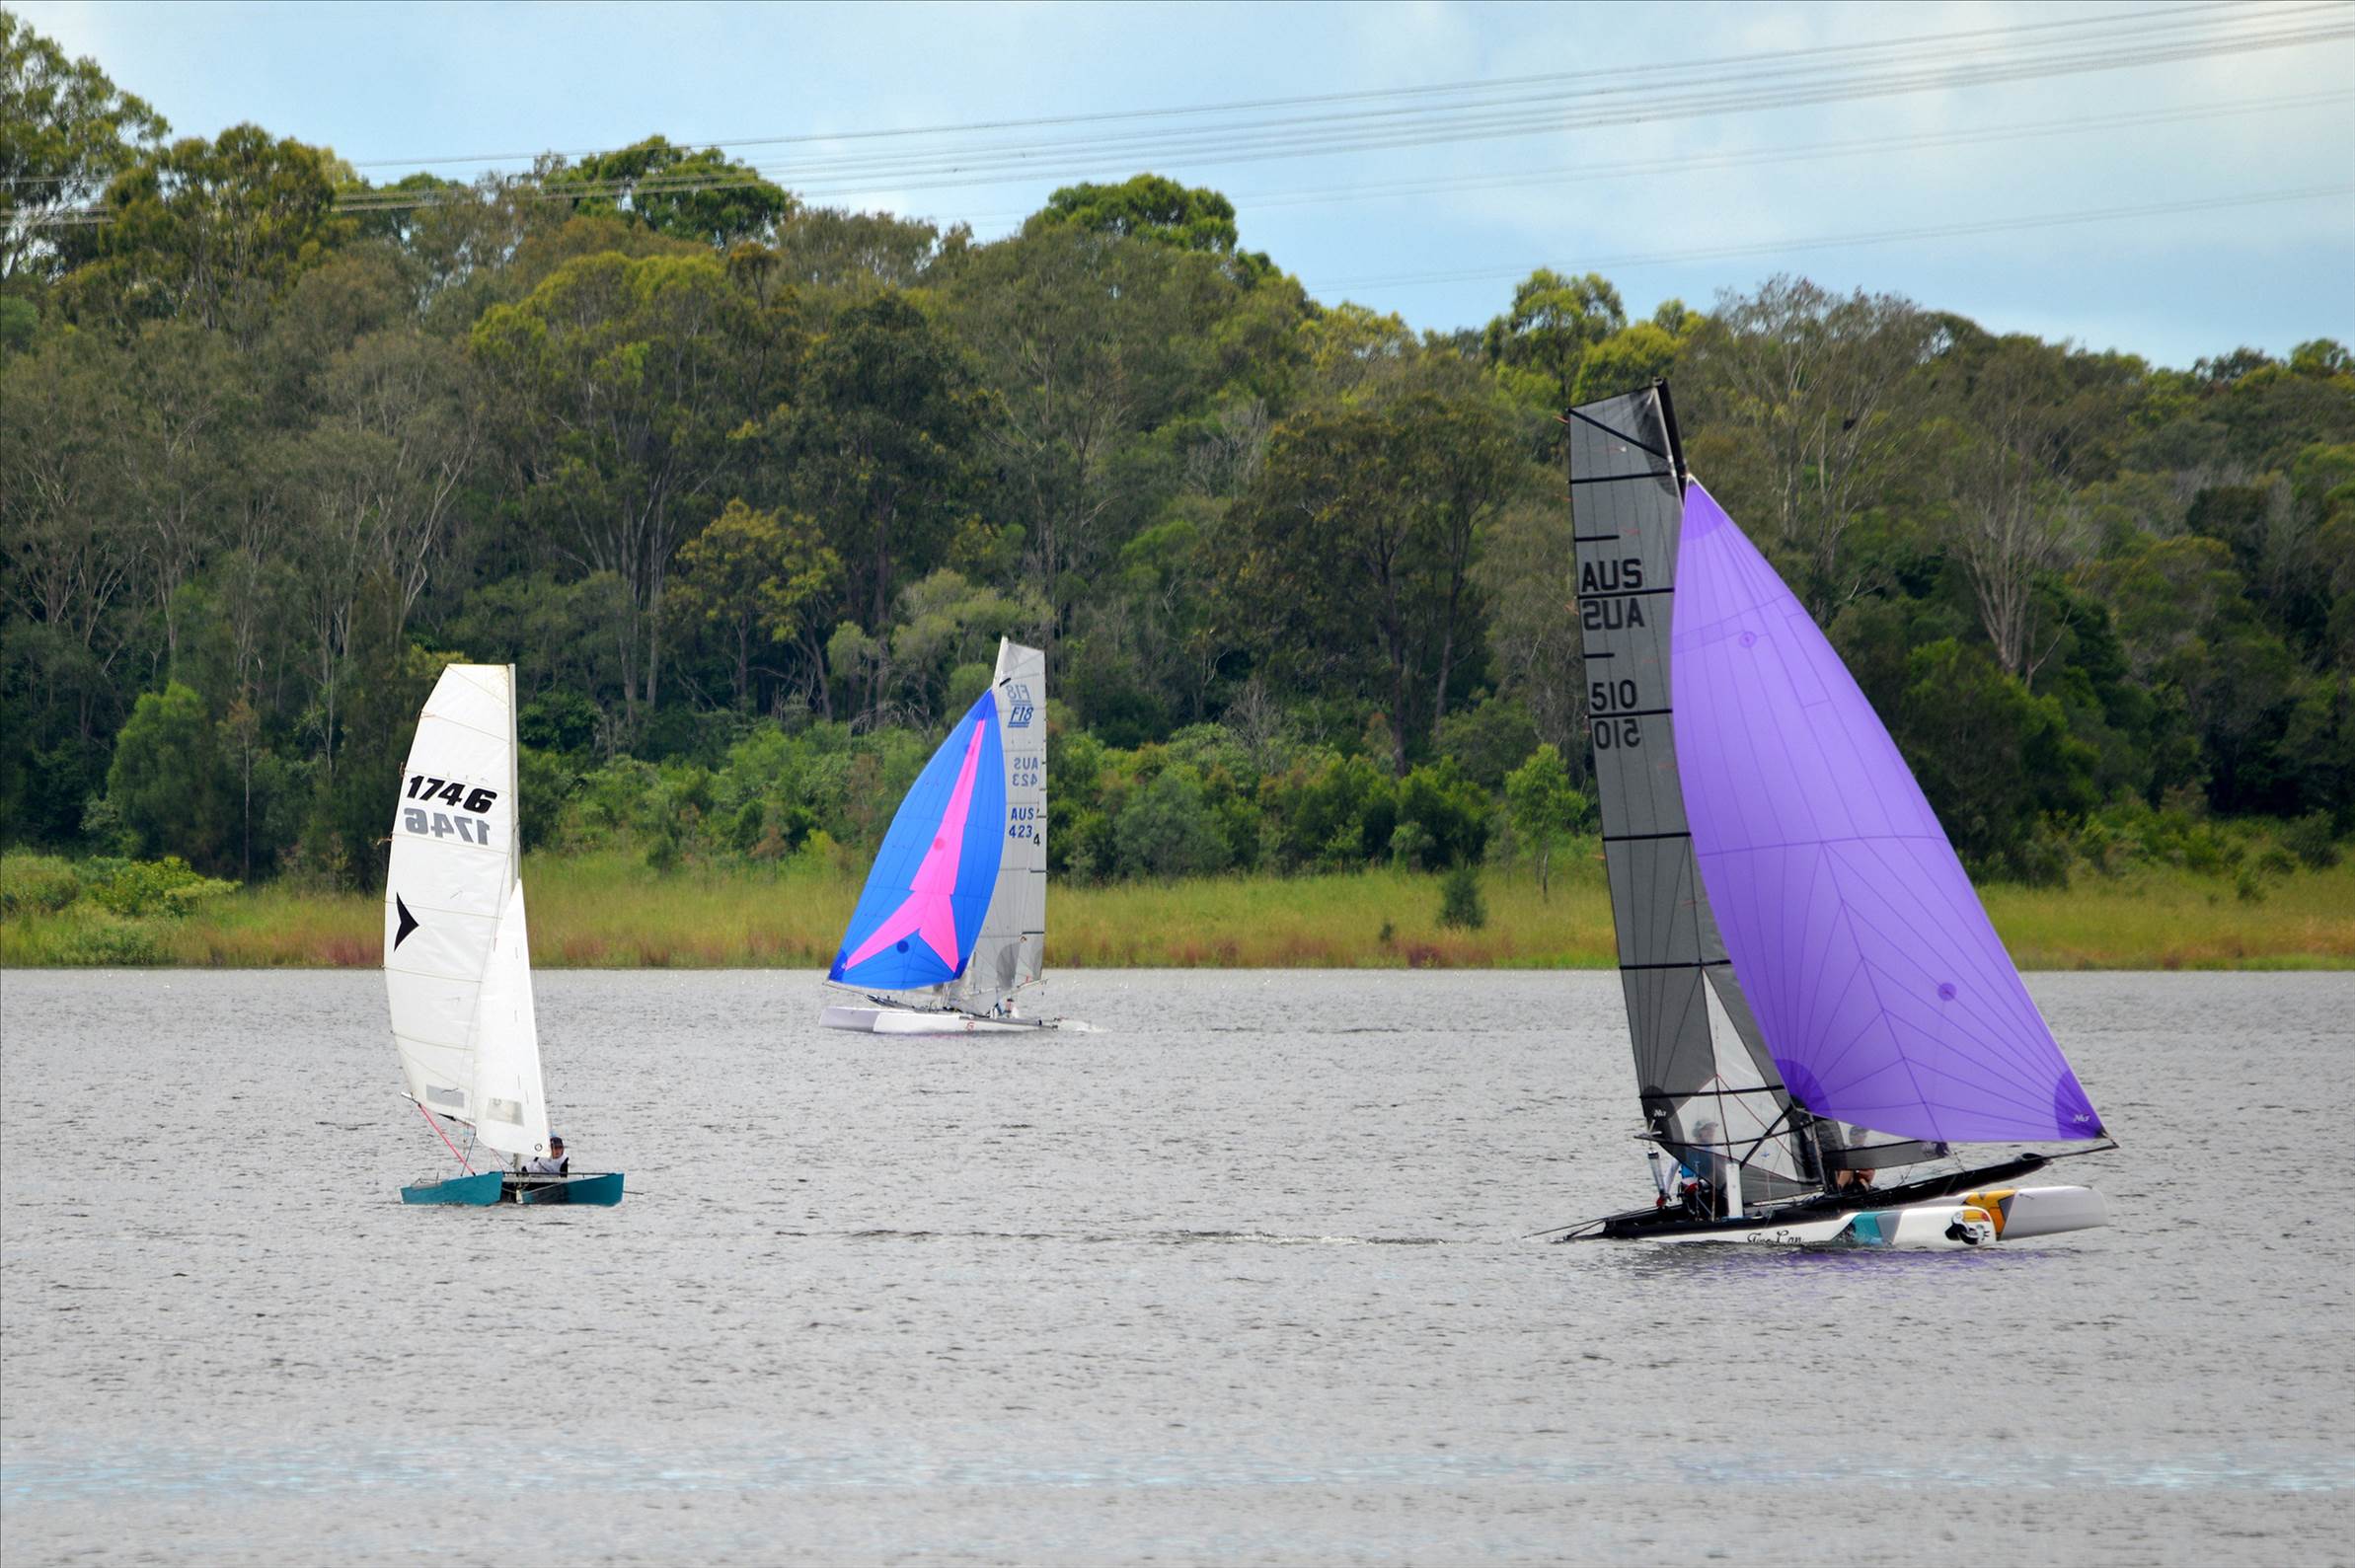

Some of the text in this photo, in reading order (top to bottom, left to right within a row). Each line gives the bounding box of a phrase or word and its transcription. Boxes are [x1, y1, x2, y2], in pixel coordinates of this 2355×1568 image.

[1581, 559, 1642, 592] AUS
[1591, 680, 1637, 711] 510
[1010, 707, 1034, 721] F18
[407, 776, 497, 814] 1746
[1011, 807, 1034, 821] AUS
[1009, 824, 1032, 839] 423
